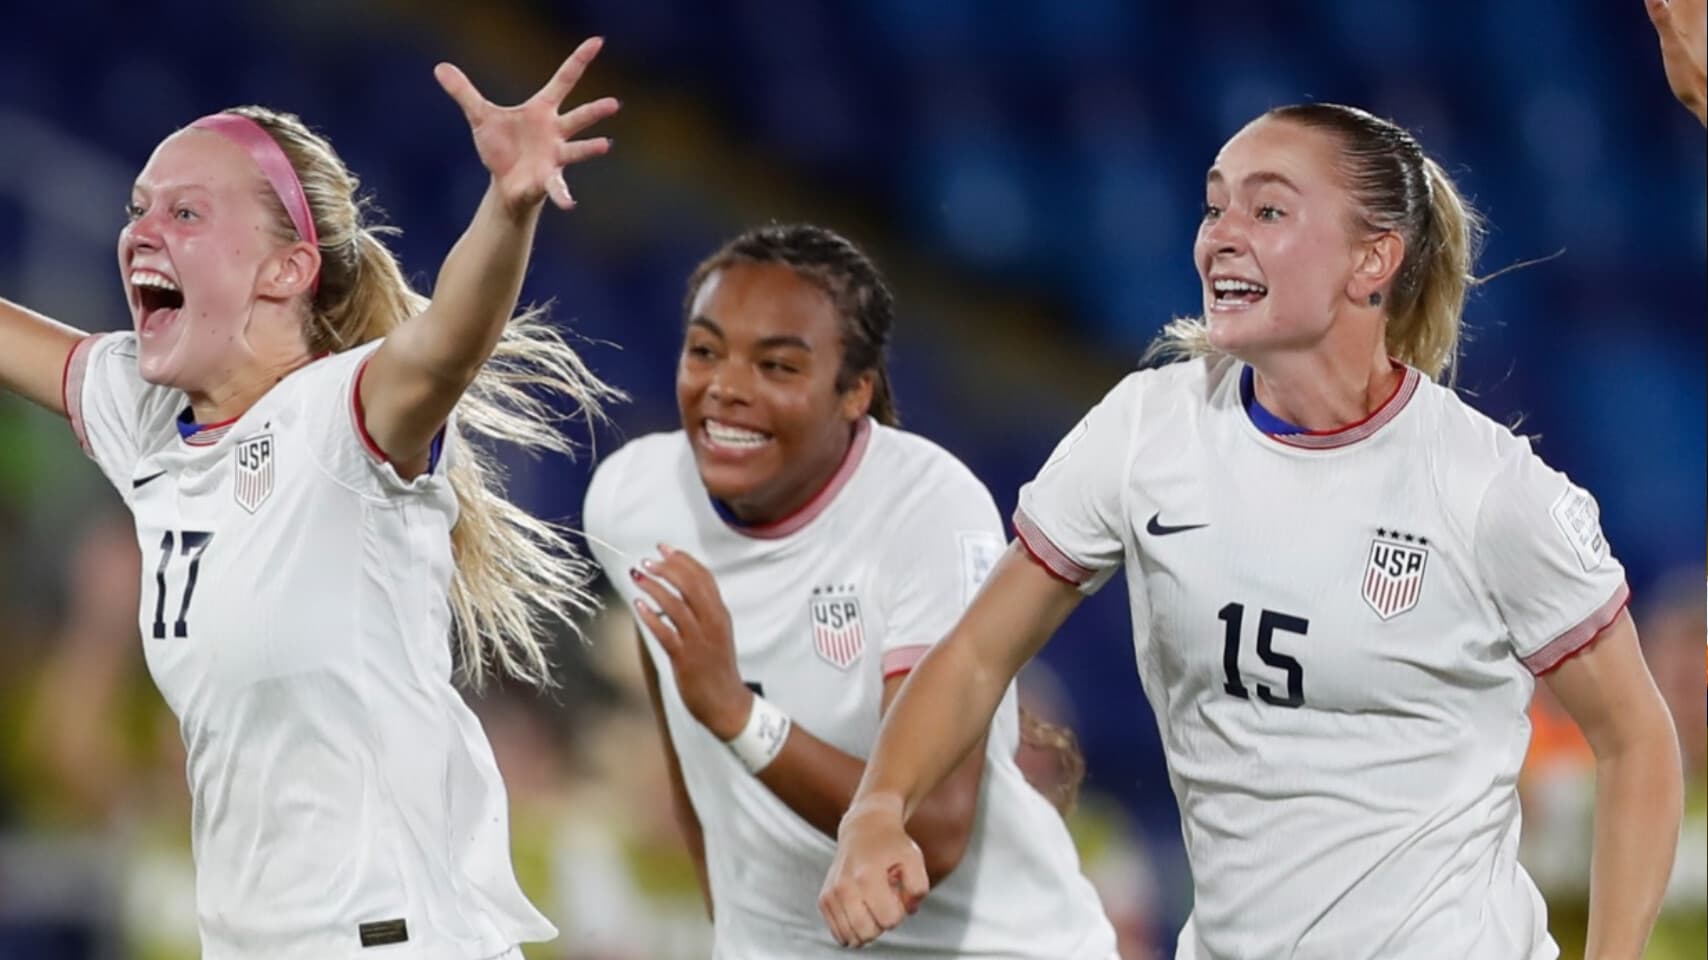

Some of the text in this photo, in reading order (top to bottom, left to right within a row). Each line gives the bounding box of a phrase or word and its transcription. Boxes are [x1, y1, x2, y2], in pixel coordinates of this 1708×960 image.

[239, 440, 271, 471] USA
[1374, 545, 1422, 578] USA
[153, 530, 216, 639] 17
[814, 602, 857, 630] USA
[1217, 601, 1309, 709] 15
